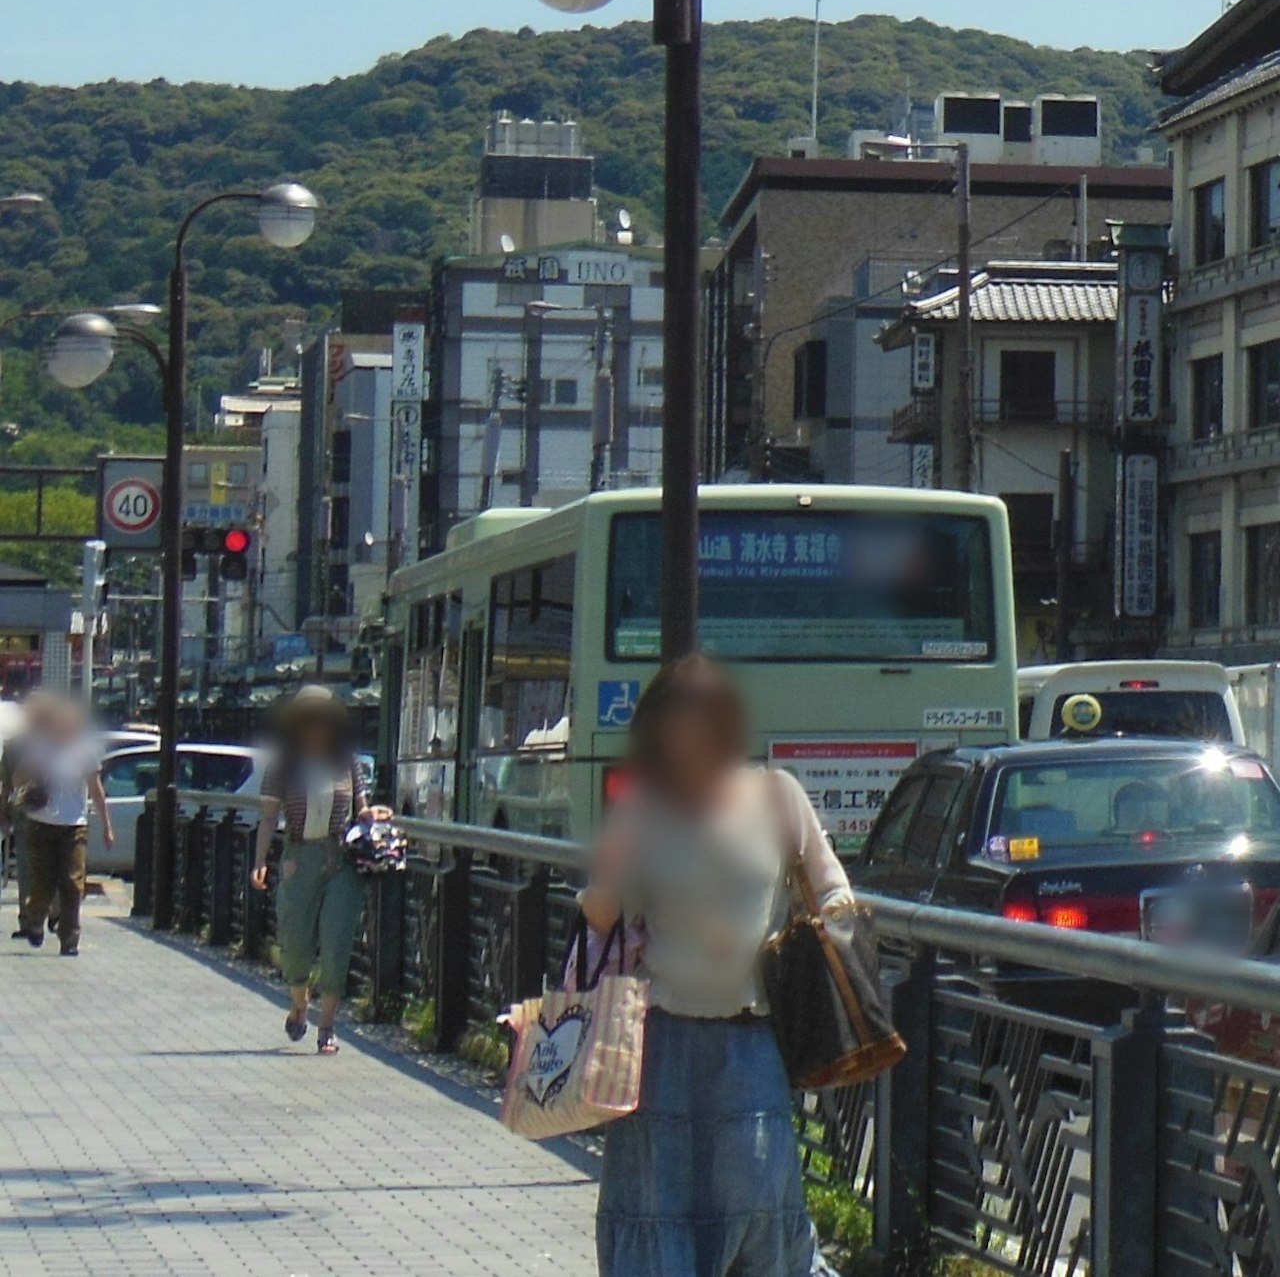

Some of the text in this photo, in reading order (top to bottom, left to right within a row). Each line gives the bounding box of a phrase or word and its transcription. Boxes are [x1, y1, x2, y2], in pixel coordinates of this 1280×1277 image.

[577, 261, 626, 282] UNO
[119, 494, 148, 518] 40
[740, 532, 787, 563] 清水寺
[794, 532, 842, 563] 東福寺
[804, 788, 893, 810] 三信工務
